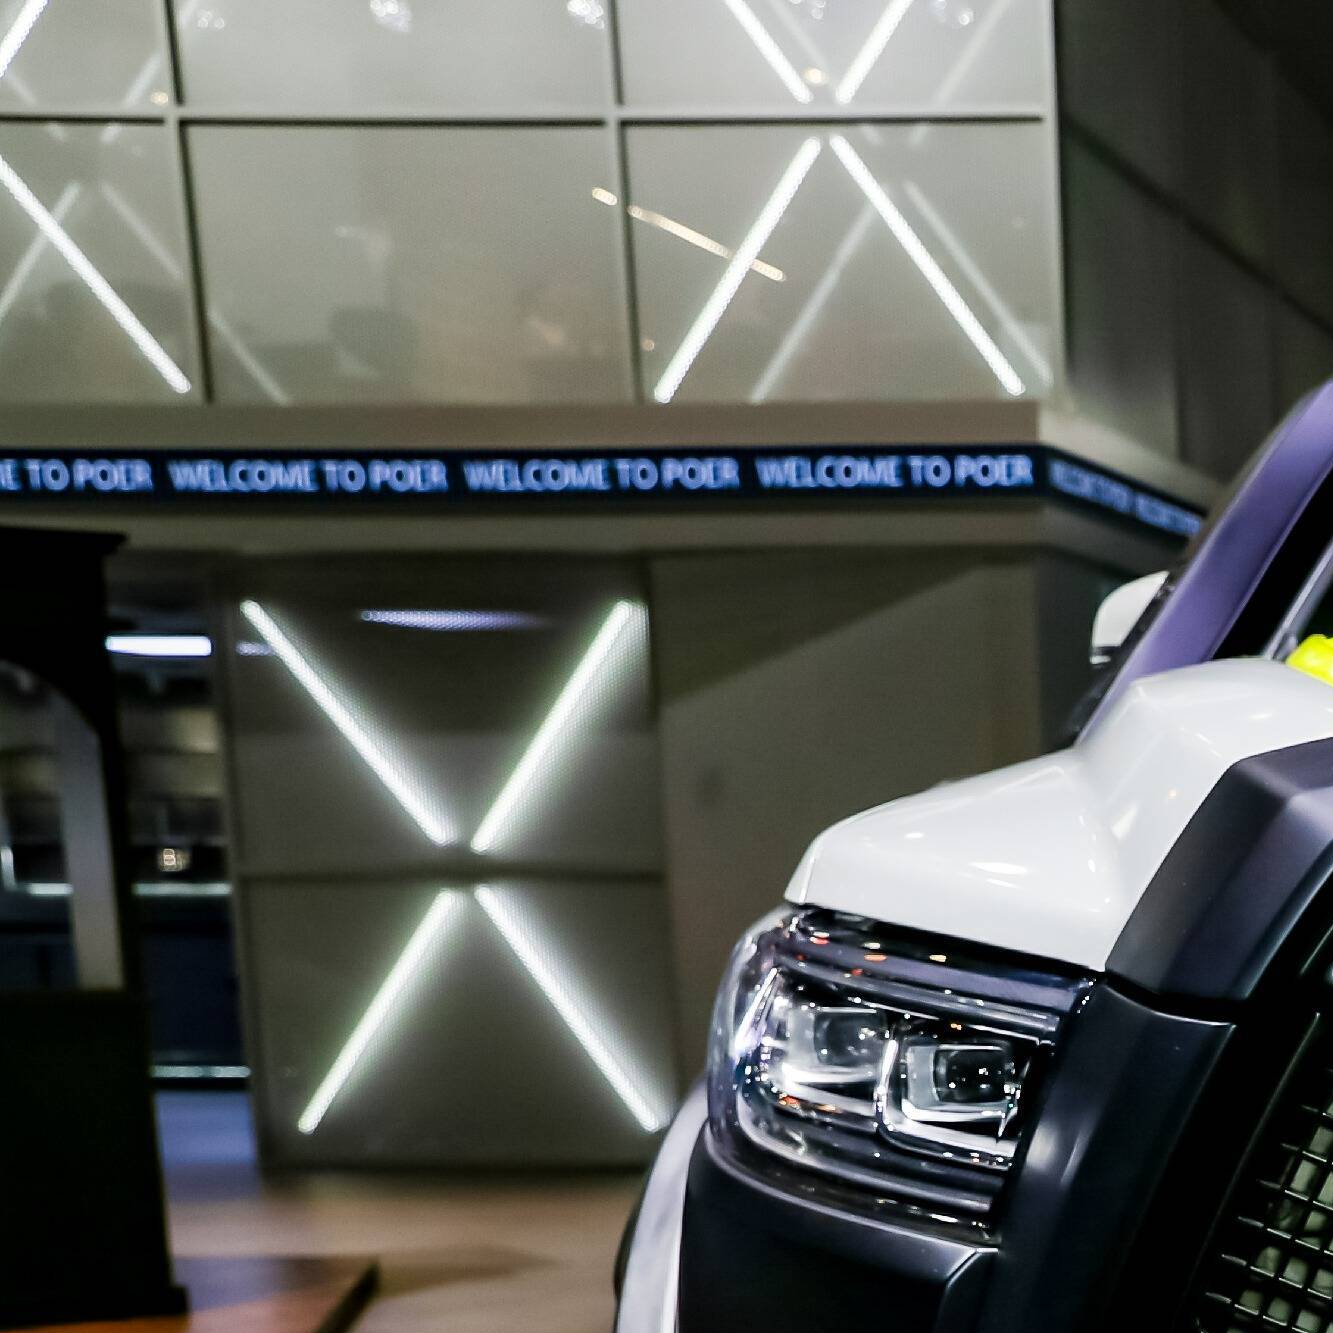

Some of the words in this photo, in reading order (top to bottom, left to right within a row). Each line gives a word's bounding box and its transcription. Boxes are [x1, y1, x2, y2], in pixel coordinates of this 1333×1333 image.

[26, 459, 70, 490] TO
[73, 459, 153, 491] POER
[168, 459, 318, 492] WELCOME
[323, 459, 366, 491] TO
[369, 459, 448, 492] POER
[463, 458, 611, 491] WELCOME
[616, 458, 660, 490] TO
[661, 457, 741, 489] POER
[755, 455, 902, 488] WELCOME
[908, 454, 952, 487] TO
[954, 453, 1035, 487] POER
